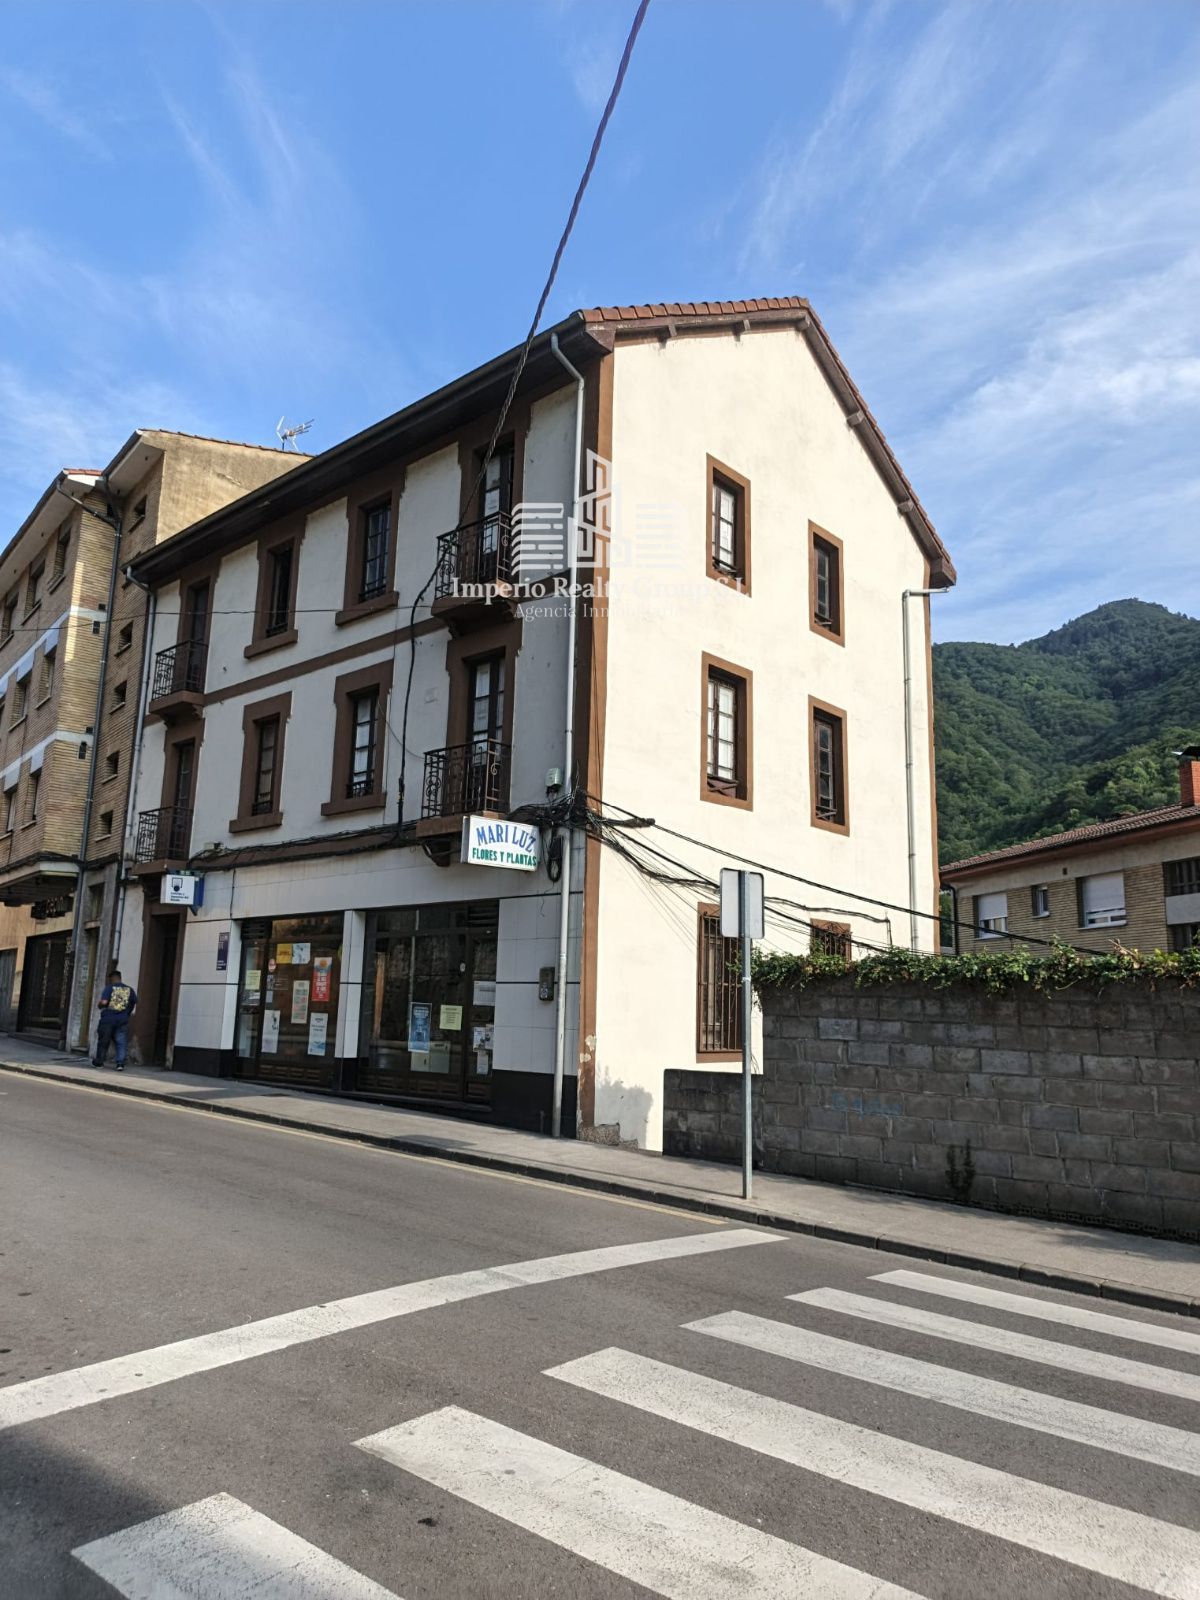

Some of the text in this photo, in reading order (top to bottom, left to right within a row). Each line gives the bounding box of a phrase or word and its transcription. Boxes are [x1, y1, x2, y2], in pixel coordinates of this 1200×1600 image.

[476, 824, 537, 853] MARI LUZ
[472, 847, 537, 867] FLORES Y PLANTAS
